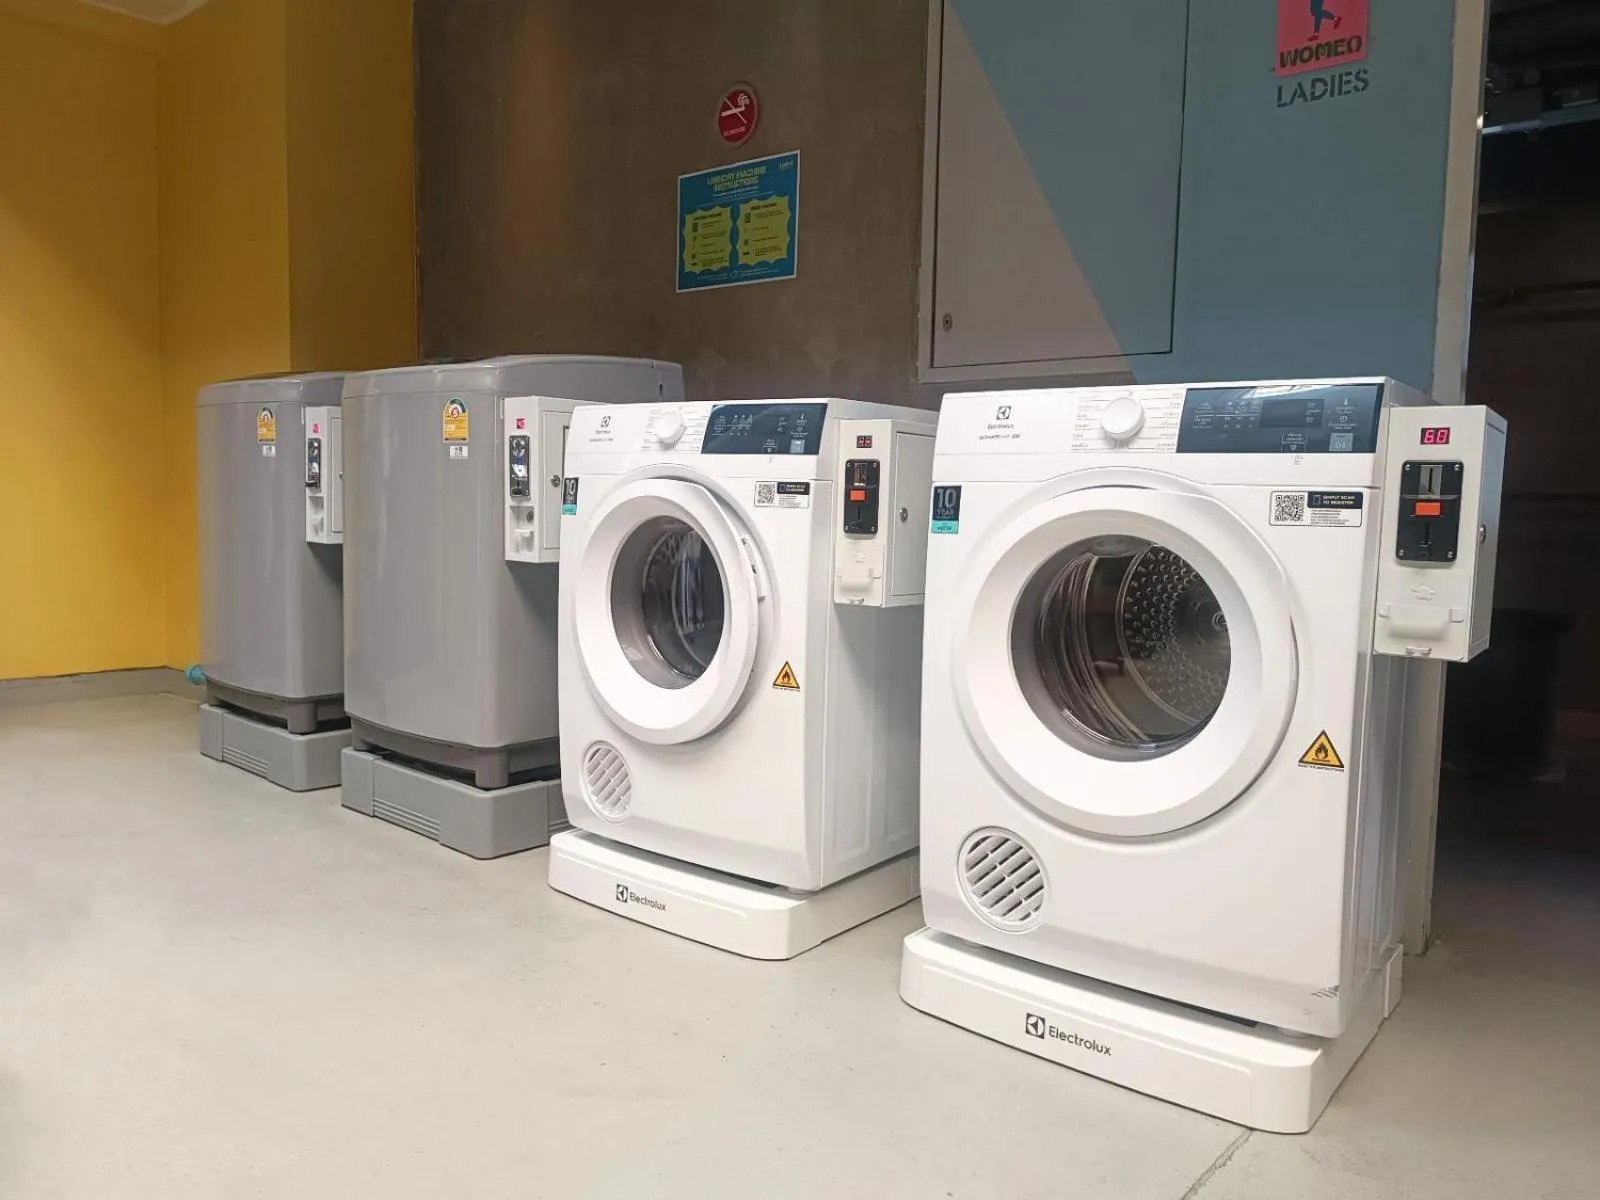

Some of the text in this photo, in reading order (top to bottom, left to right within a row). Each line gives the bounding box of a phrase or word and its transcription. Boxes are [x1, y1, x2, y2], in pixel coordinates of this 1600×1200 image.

[1276, 67, 1370, 108] LADIES
[1423, 429, 1449, 443] 60
[937, 488, 957, 509] 10
[629, 891, 667, 911] Electrolux
[1048, 1025, 1112, 1056] Electrolux
